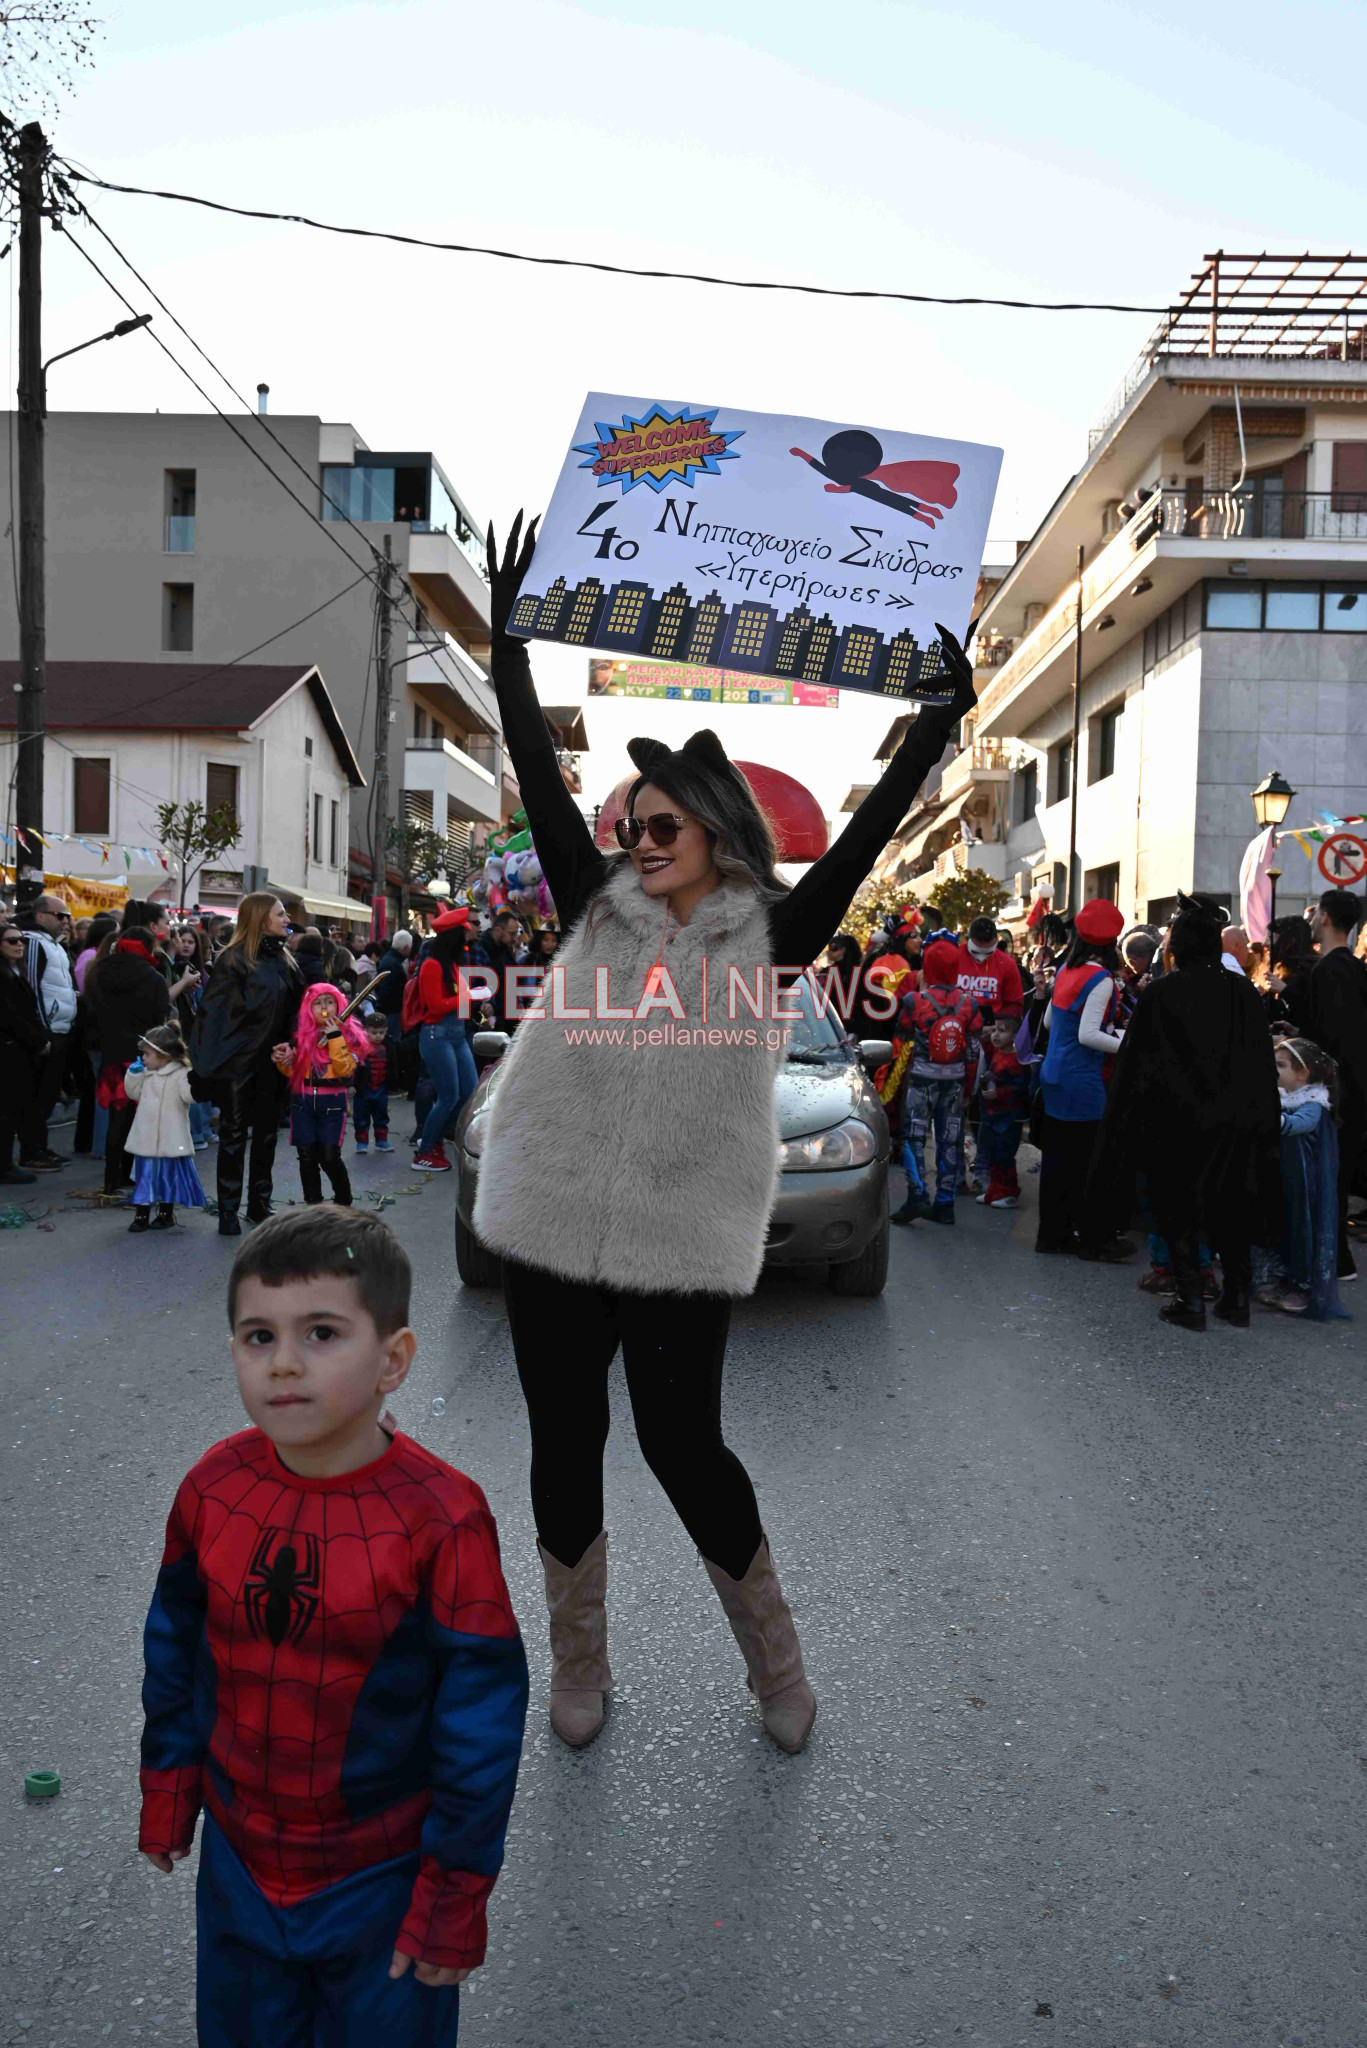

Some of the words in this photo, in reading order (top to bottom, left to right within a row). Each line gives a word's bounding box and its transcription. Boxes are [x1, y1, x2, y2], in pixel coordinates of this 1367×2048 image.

[597, 420, 712, 458] WELCOME
[592, 439, 726, 476] SUPERHEROES
[653, 498, 832, 564] Νηπιαγωγείο
[838, 525, 963, 585] Σκύδρας
[627, 665, 682, 676] ΜΕΓΑΛΗ
[626, 675, 700, 687] ΠΑΡΕΛΑΣΗ
[704, 678, 730, 688] ΣΤΗ
[733, 679, 785, 690] ΣΚΥΔΡΑ
[666, 688, 682, 699] 22
[723, 690, 759, 702] 2026
[956, 974, 998, 992] JOKER
